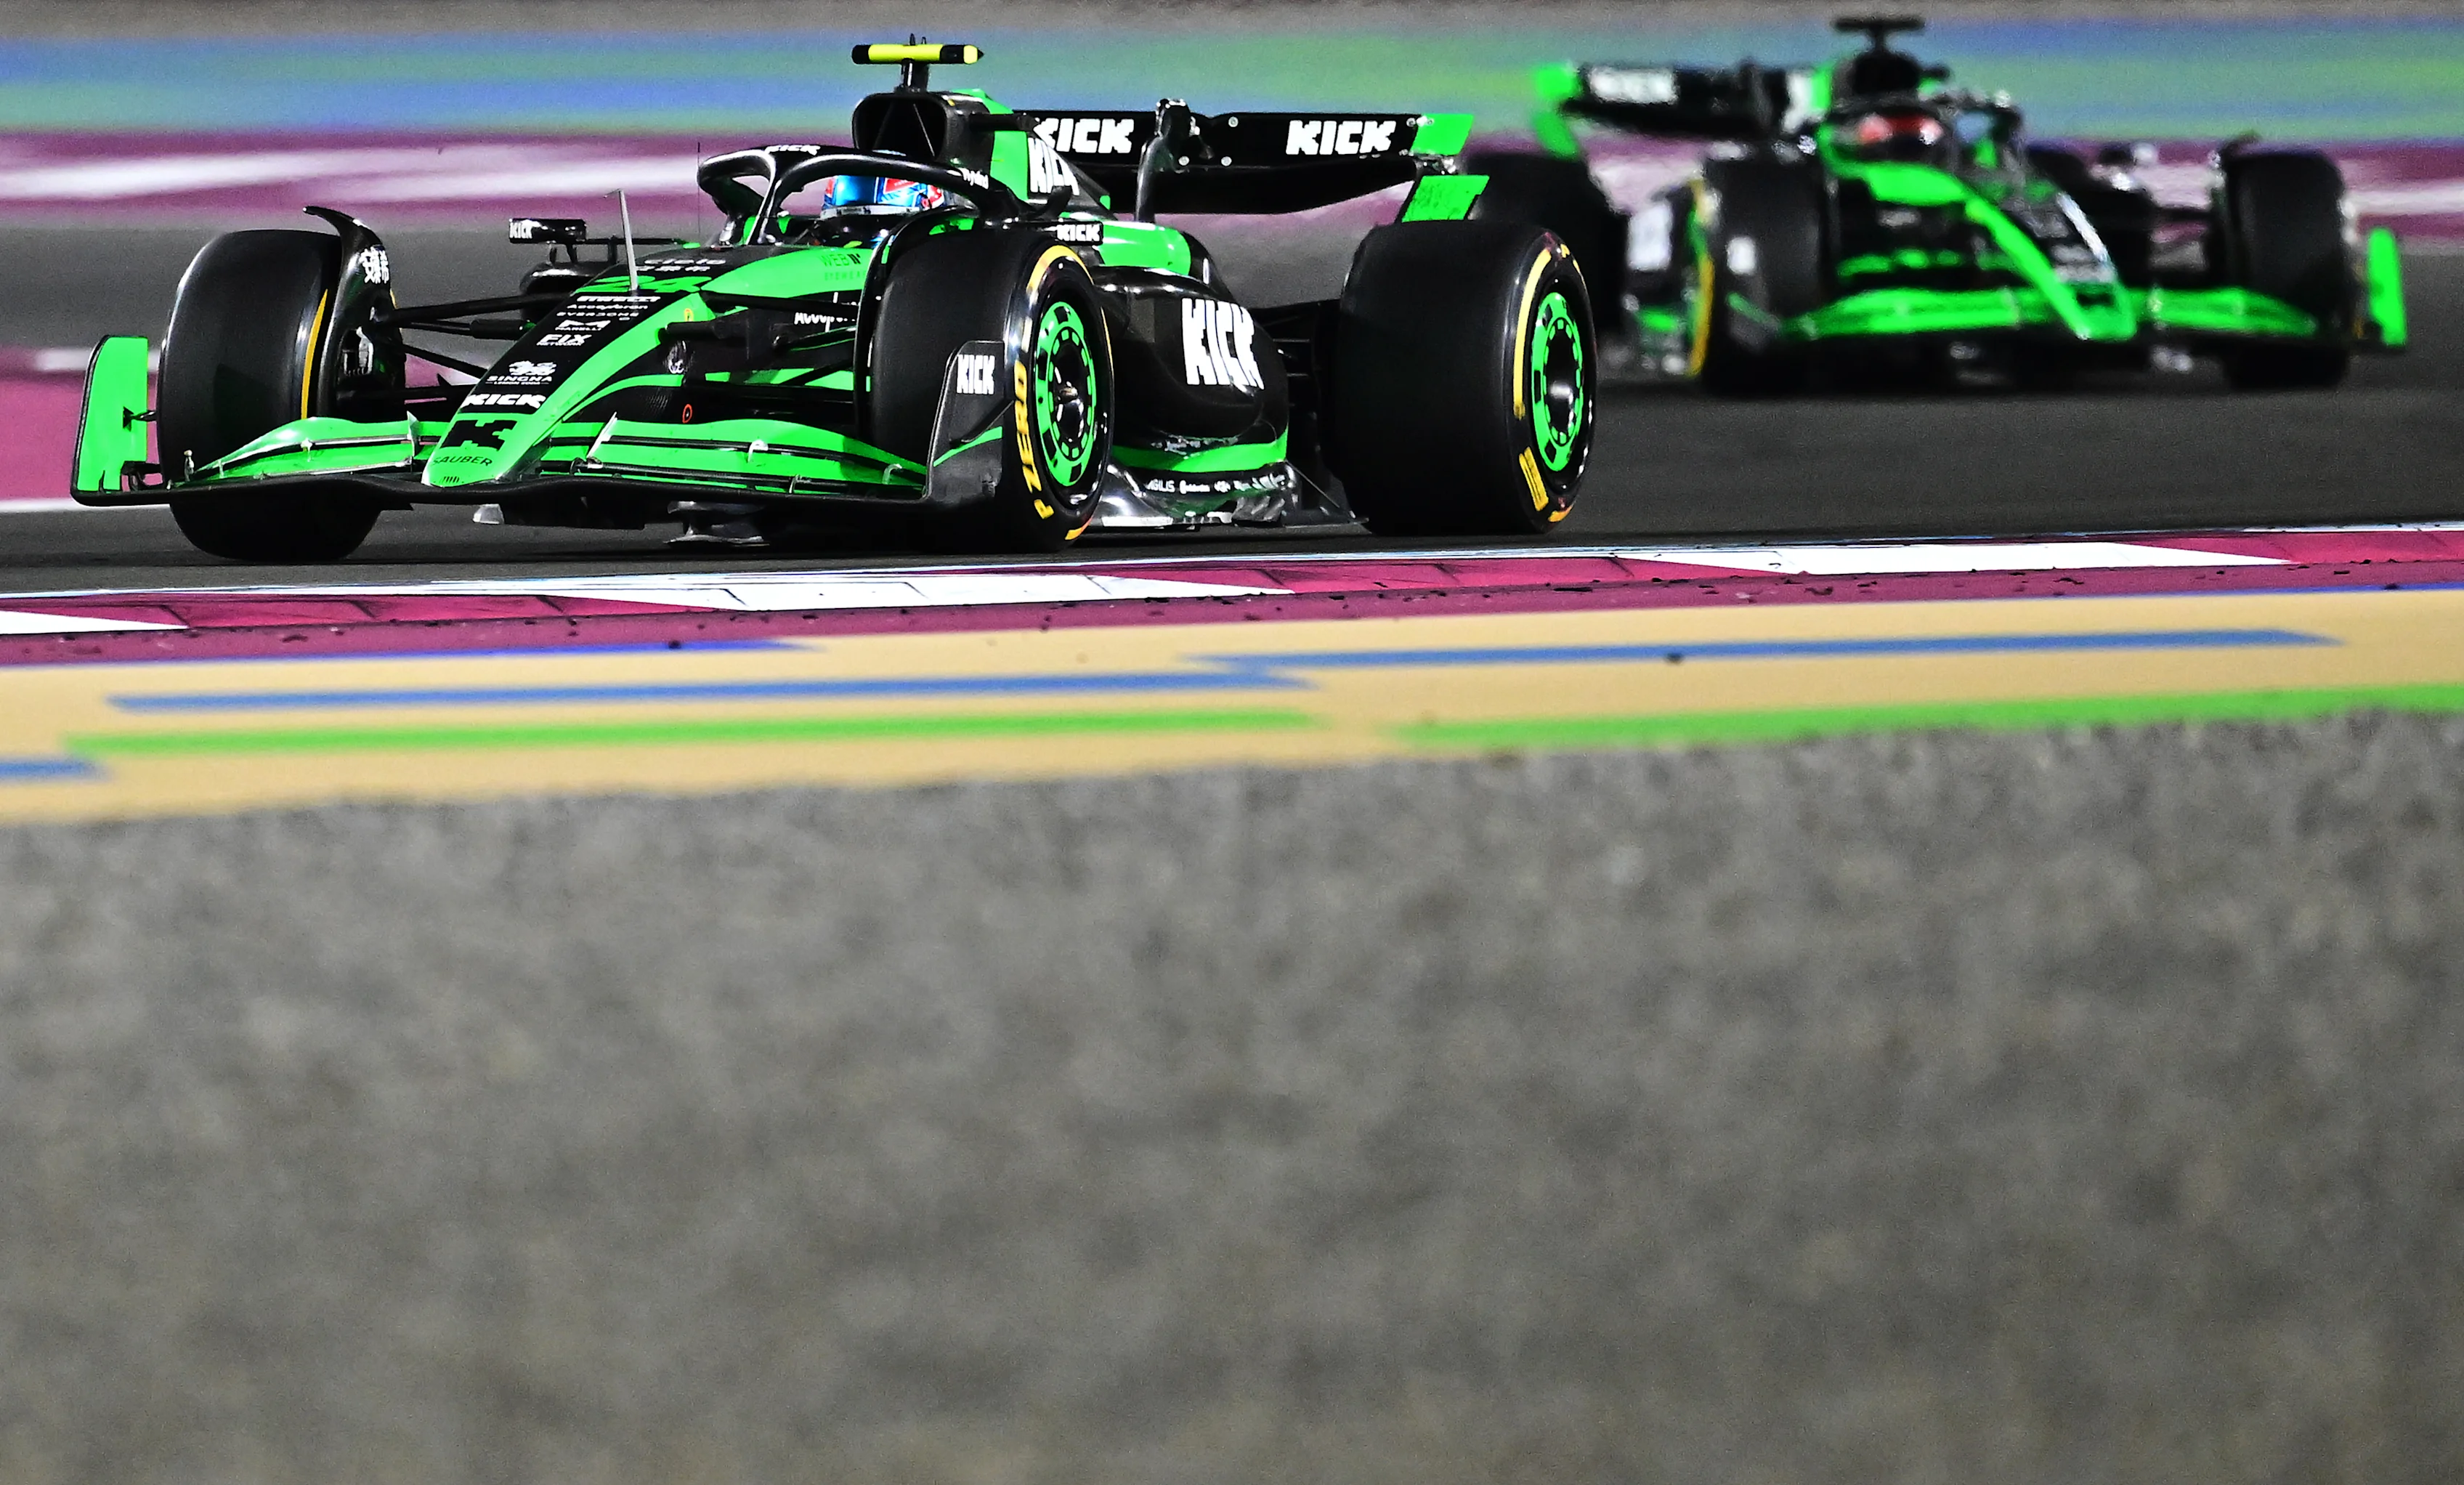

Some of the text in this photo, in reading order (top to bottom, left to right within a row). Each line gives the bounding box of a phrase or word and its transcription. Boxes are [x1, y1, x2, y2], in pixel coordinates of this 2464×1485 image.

[1033, 118, 1135, 154] KICK
[1285, 120, 1397, 155] KICK
[1057, 224, 1101, 242] KICK
[538, 333, 593, 343] FIX
[1180, 298, 1265, 391] KICK
[957, 354, 996, 395] KICK
[459, 394, 546, 409] KICK
[1014, 360, 1042, 494] ZERO
[433, 456, 493, 466] SAUBER
